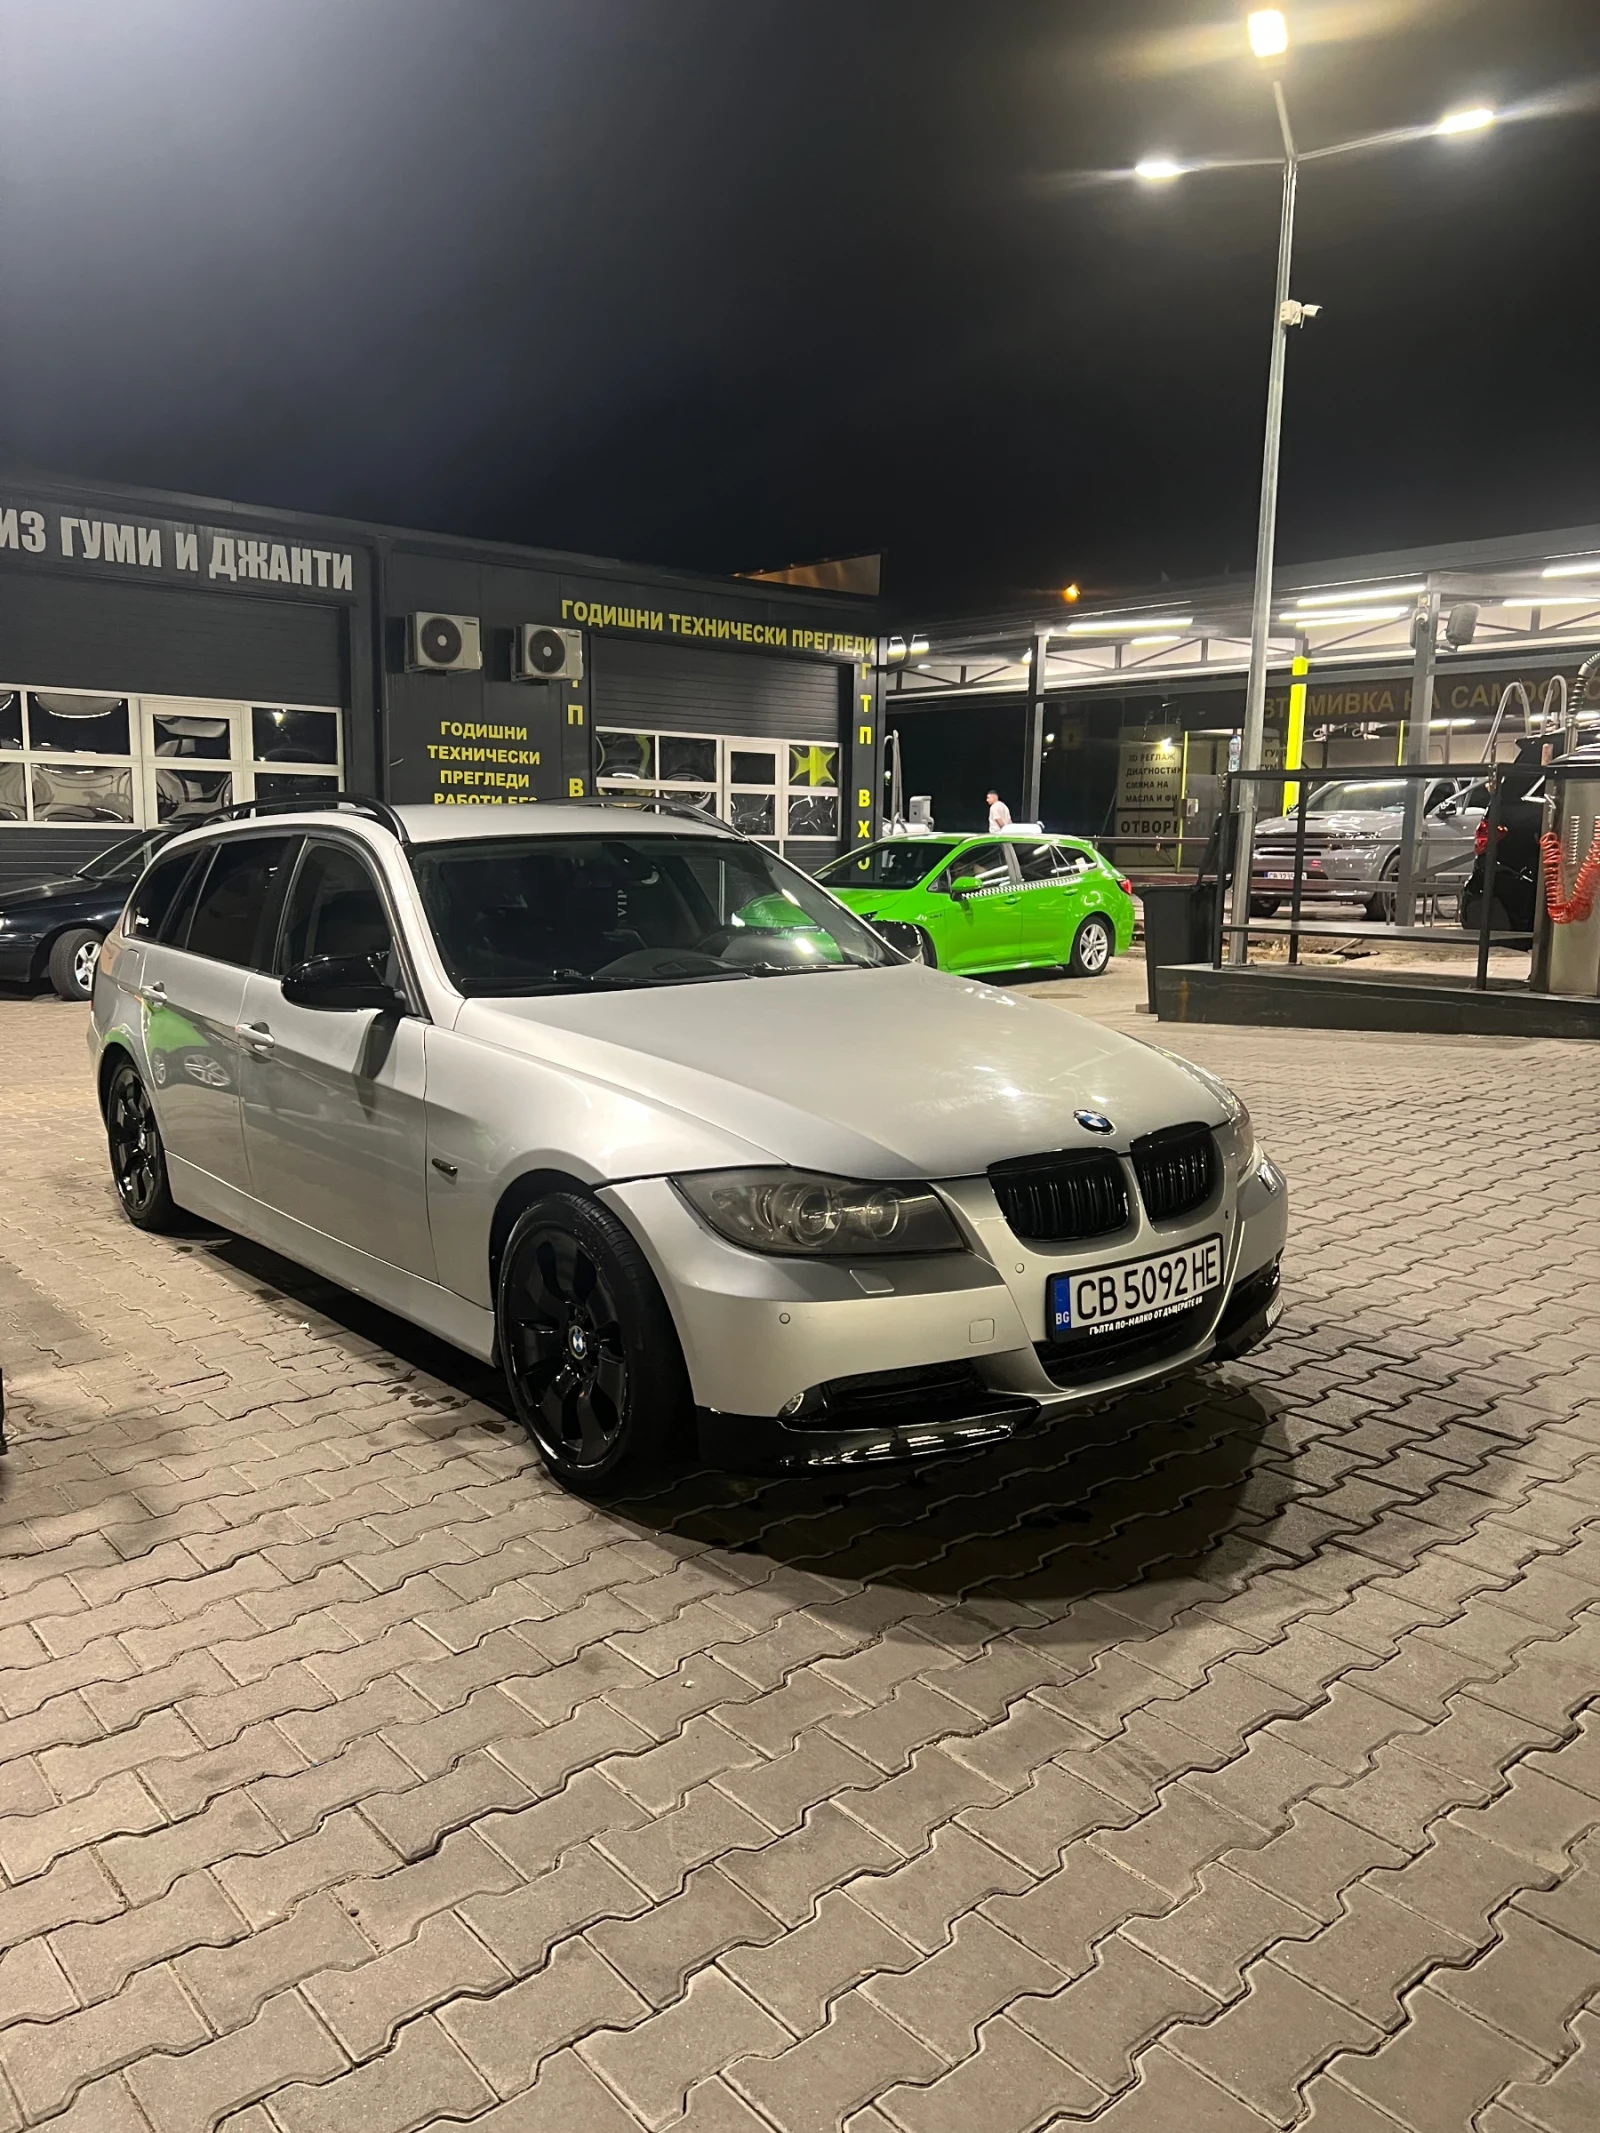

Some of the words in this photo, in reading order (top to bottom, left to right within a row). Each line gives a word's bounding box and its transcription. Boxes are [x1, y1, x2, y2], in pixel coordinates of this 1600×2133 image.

[60, 516, 162, 568] ГУМИ
[175, 531, 199, 572] И
[208, 535, 353, 591] ДЖАНТИ
[561, 599, 664, 632] ГОДИШНИ
[669, 613, 788, 646] ТЕХНИЧЕСКИ
[792, 629, 876, 658] ПРЕГЛЕДИ
[440, 721, 528, 741] ГОДИШНИ
[427, 745, 541, 765] ТЕХНИЧЕСКИ
[440, 770, 530, 790] ПРЕГЛЕДИ
[1125, 781, 1154, 789] СМЯНА
[1125, 794, 1154, 803] МАСЛА
[1077, 1276, 1118, 1320] CB
[1124, 1257, 1188, 1310] 5092
[1192, 1244, 1218, 1291] HE
[1055, 1312, 1070, 1325] BG
[1115, 1311, 1153, 1330] ПО-МАЛКО
[1153, 1308, 1163, 1319] ОТ
